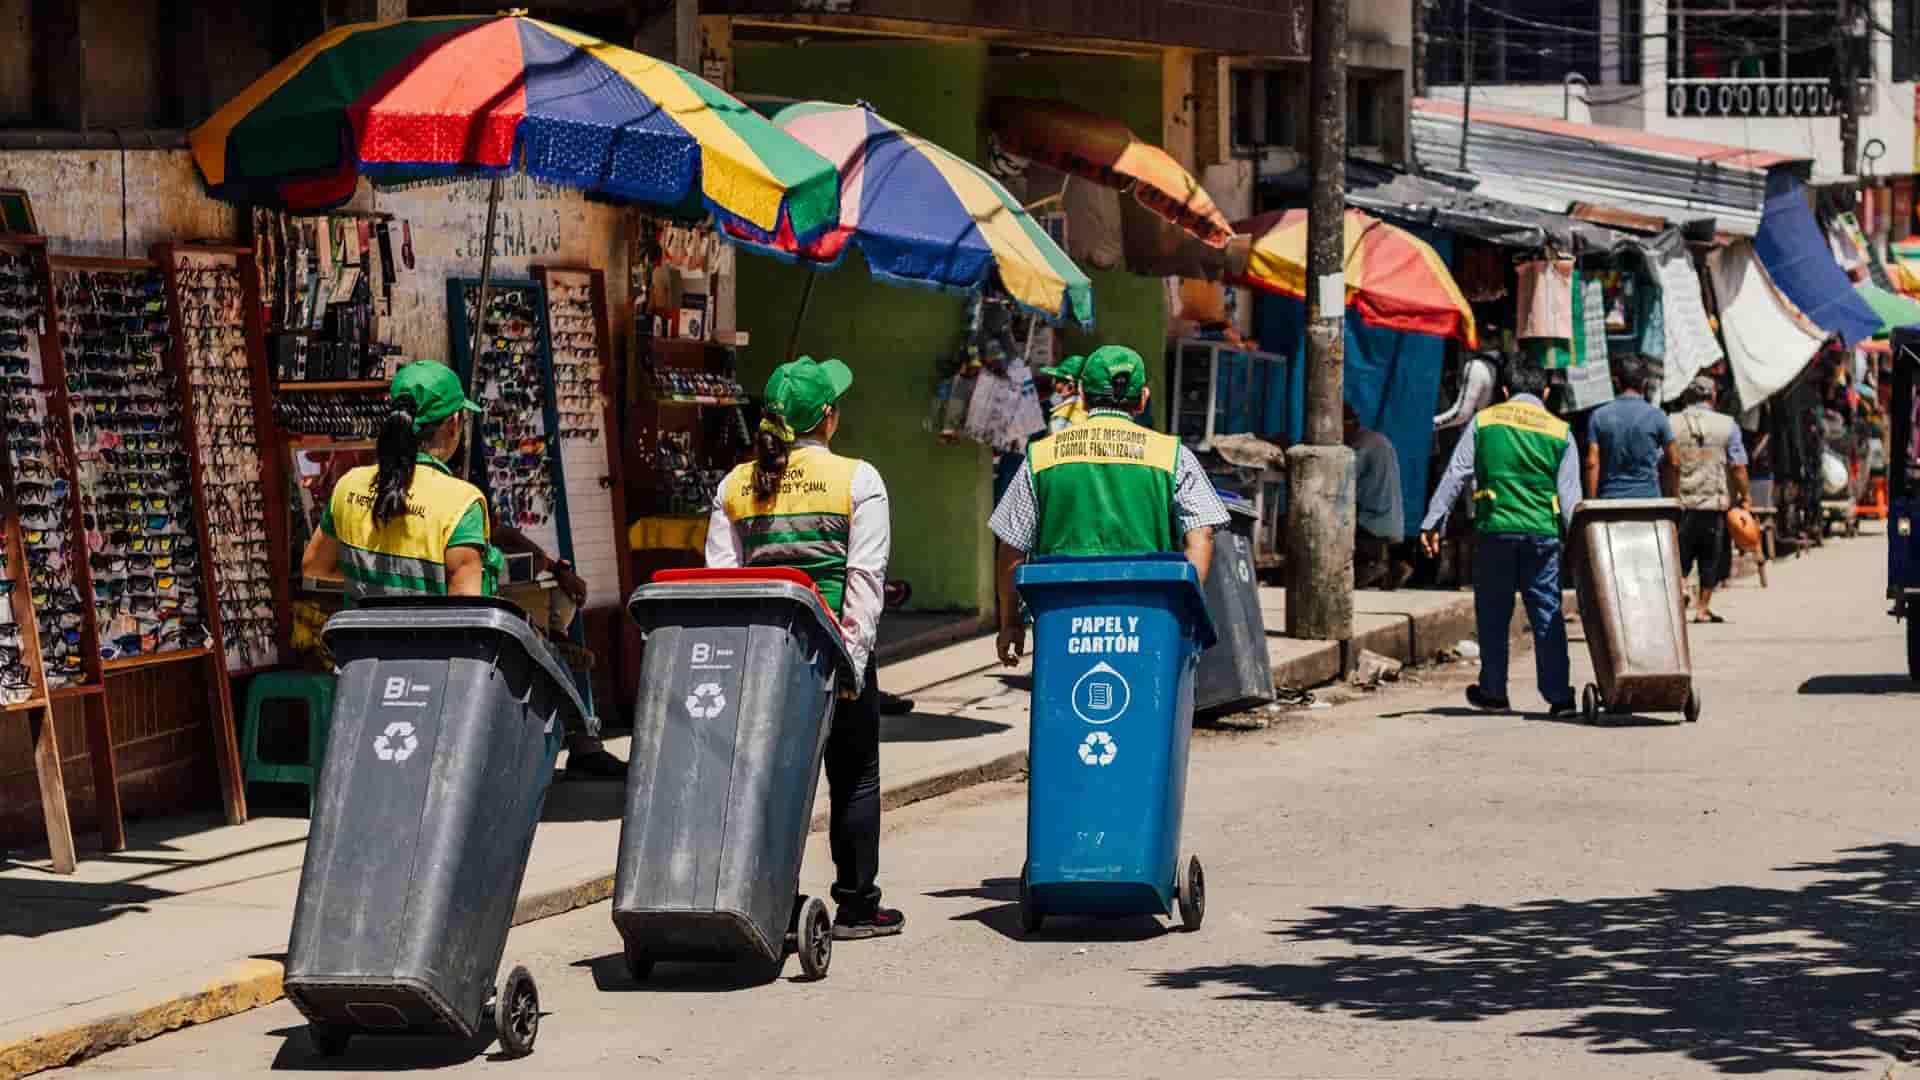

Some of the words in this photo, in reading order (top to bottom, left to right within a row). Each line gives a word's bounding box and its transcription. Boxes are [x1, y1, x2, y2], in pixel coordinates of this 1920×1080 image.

[1071, 616, 1122, 633] PAPEL
[1127, 616, 1138, 632] Y
[1068, 633, 1139, 653] CARTÓN
